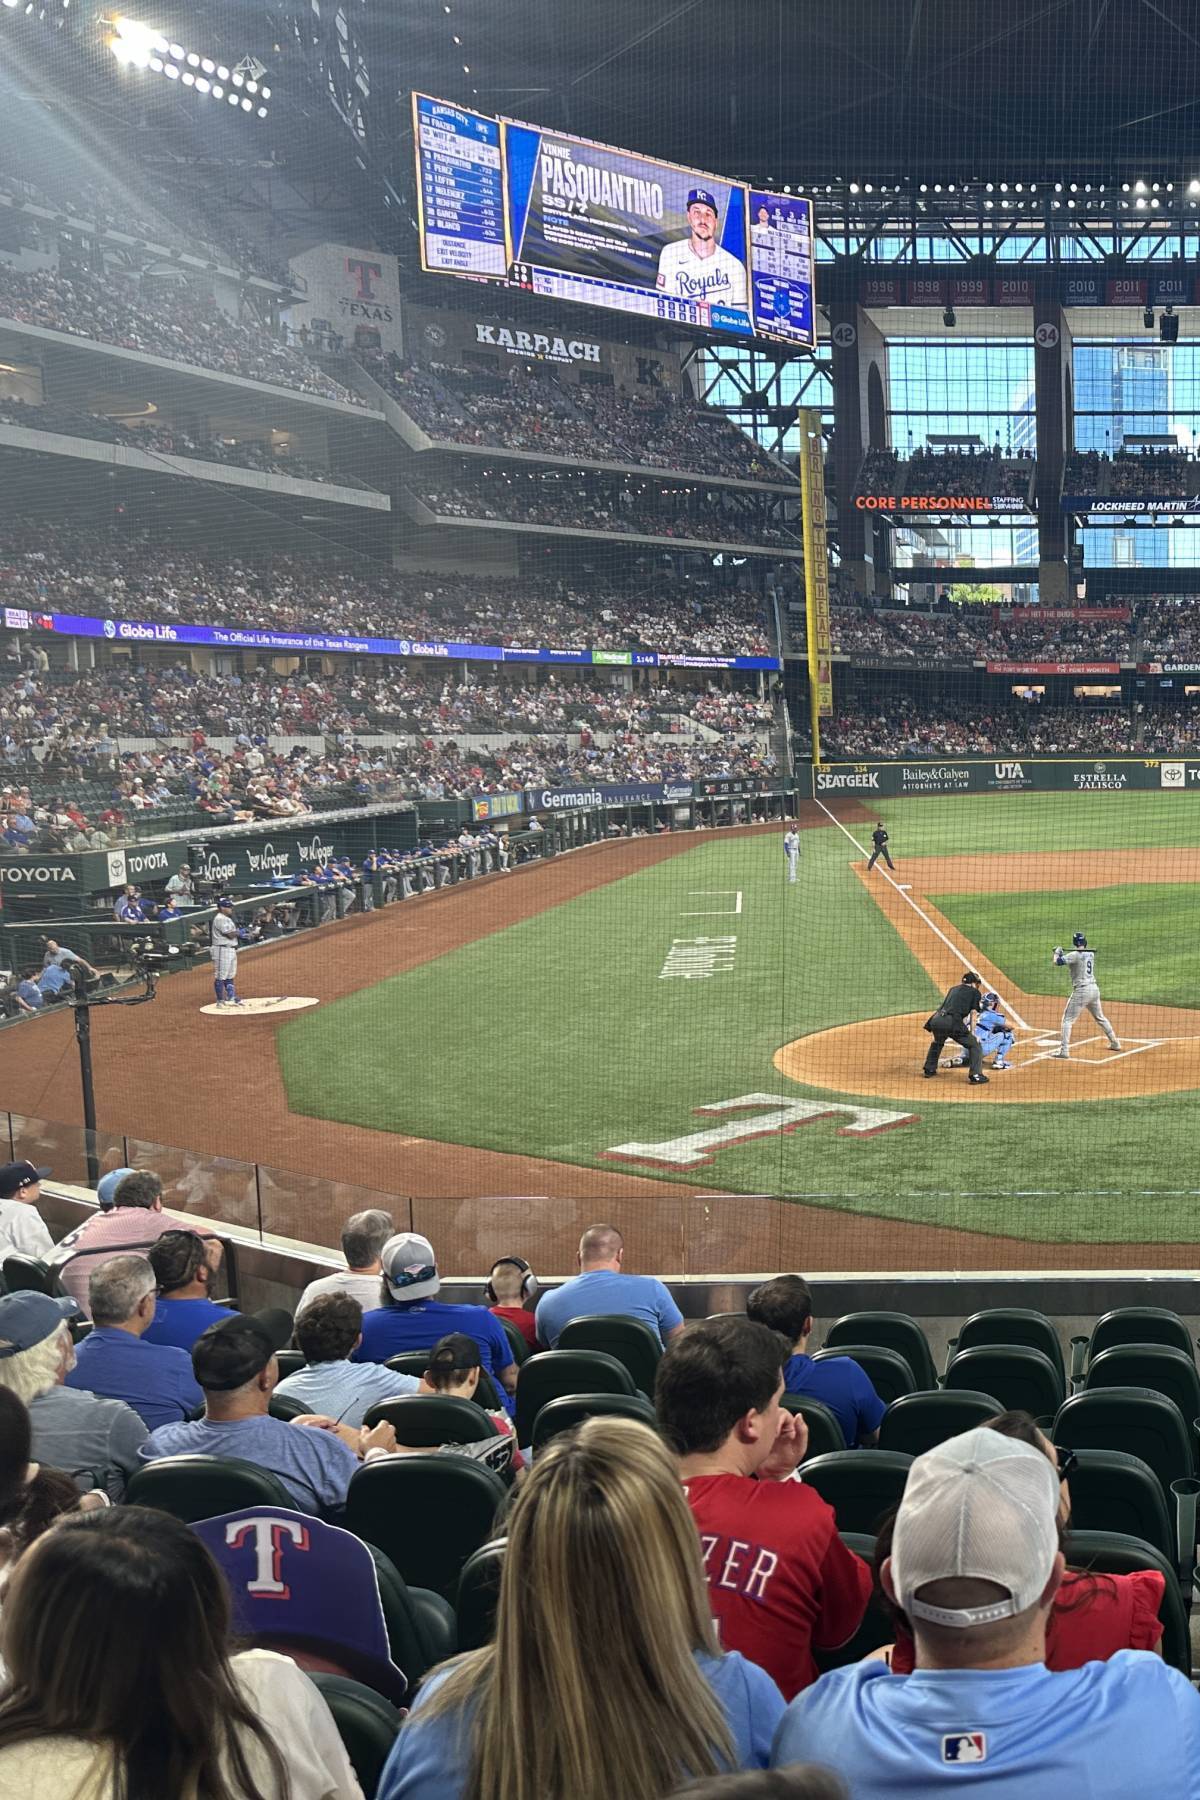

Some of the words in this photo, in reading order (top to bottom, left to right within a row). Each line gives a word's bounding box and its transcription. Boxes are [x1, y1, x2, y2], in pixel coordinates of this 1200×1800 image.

[542, 142, 572, 160] VINNIE
[434, 163, 454, 176] PEREZ
[541, 154, 663, 220] PASQUANTINO
[542, 194, 566, 208] SS
[436, 208, 458, 220] GARCIA
[543, 215, 570, 226] NOTE
[437, 219, 460, 232] BLANCO
[449, 248, 472, 259] VELOCITY
[344, 256, 382, 299] T
[676, 268, 729, 300] Royals
[866, 280, 894, 293] 1996
[912, 280, 940, 293] 1998
[956, 280, 984, 293] 1999
[1002, 280, 1028, 293] 2010
[1068, 280, 1096, 292] 2010
[1114, 280, 1140, 292] 2011
[1158, 280, 1183, 292] 2011
[338, 297, 394, 322] TEXAS
[720, 315, 738, 326] Globe
[834, 328, 853, 342] 42
[1038, 328, 1057, 342] 34
[476, 324, 600, 362] KARBACH
[506, 348, 536, 358] BREWING
[545, 354, 573, 364] COMPANY
[811, 438, 822, 522] BRING
[856, 496, 896, 510] CORE
[901, 496, 992, 510] PERSONNEL
[1090, 502, 1145, 510] LOCKHEED
[1146, 502, 1188, 510] MARTIN
[815, 529, 825, 578] THE
[816, 583, 827, 649] HEAT
[1043, 610, 1055, 618] THE
[119, 624, 154, 638] Globe
[156, 625, 177, 640] Life
[213, 632, 229, 642] The
[230, 632, 256, 643] Official
[256, 634, 270, 644] Life
[271, 636, 301, 646] Insurance
[301, 638, 312, 646] of
[312, 638, 324, 648] the
[324, 638, 342, 648] Texas
[344, 640, 368, 652] Rangers
[412, 644, 434, 654] Globe
[434, 644, 448, 656] Life
[636, 656, 654, 664] 1:40
[902, 768, 970, 782] Bailey&Galyen
[994, 762, 1024, 779] UTA
[817, 772, 880, 790] SEATGEEK
[1073, 774, 1127, 782] ESTRELLA
[902, 782, 940, 790] ATTORNEYS
[1078, 782, 1122, 790] JALISCO
[541, 788, 602, 808] Germania
[604, 794, 650, 803] INSURANCE
[308, 836, 334, 871] Kroger
[128, 852, 168, 873] TOYOTA
[204, 852, 237, 882] Kroger
[260, 843, 290, 880] Kroger
[0, 868, 76, 883] TOYOTA
[595, 1092, 921, 1172] T
[225, 1516, 310, 1600] T
